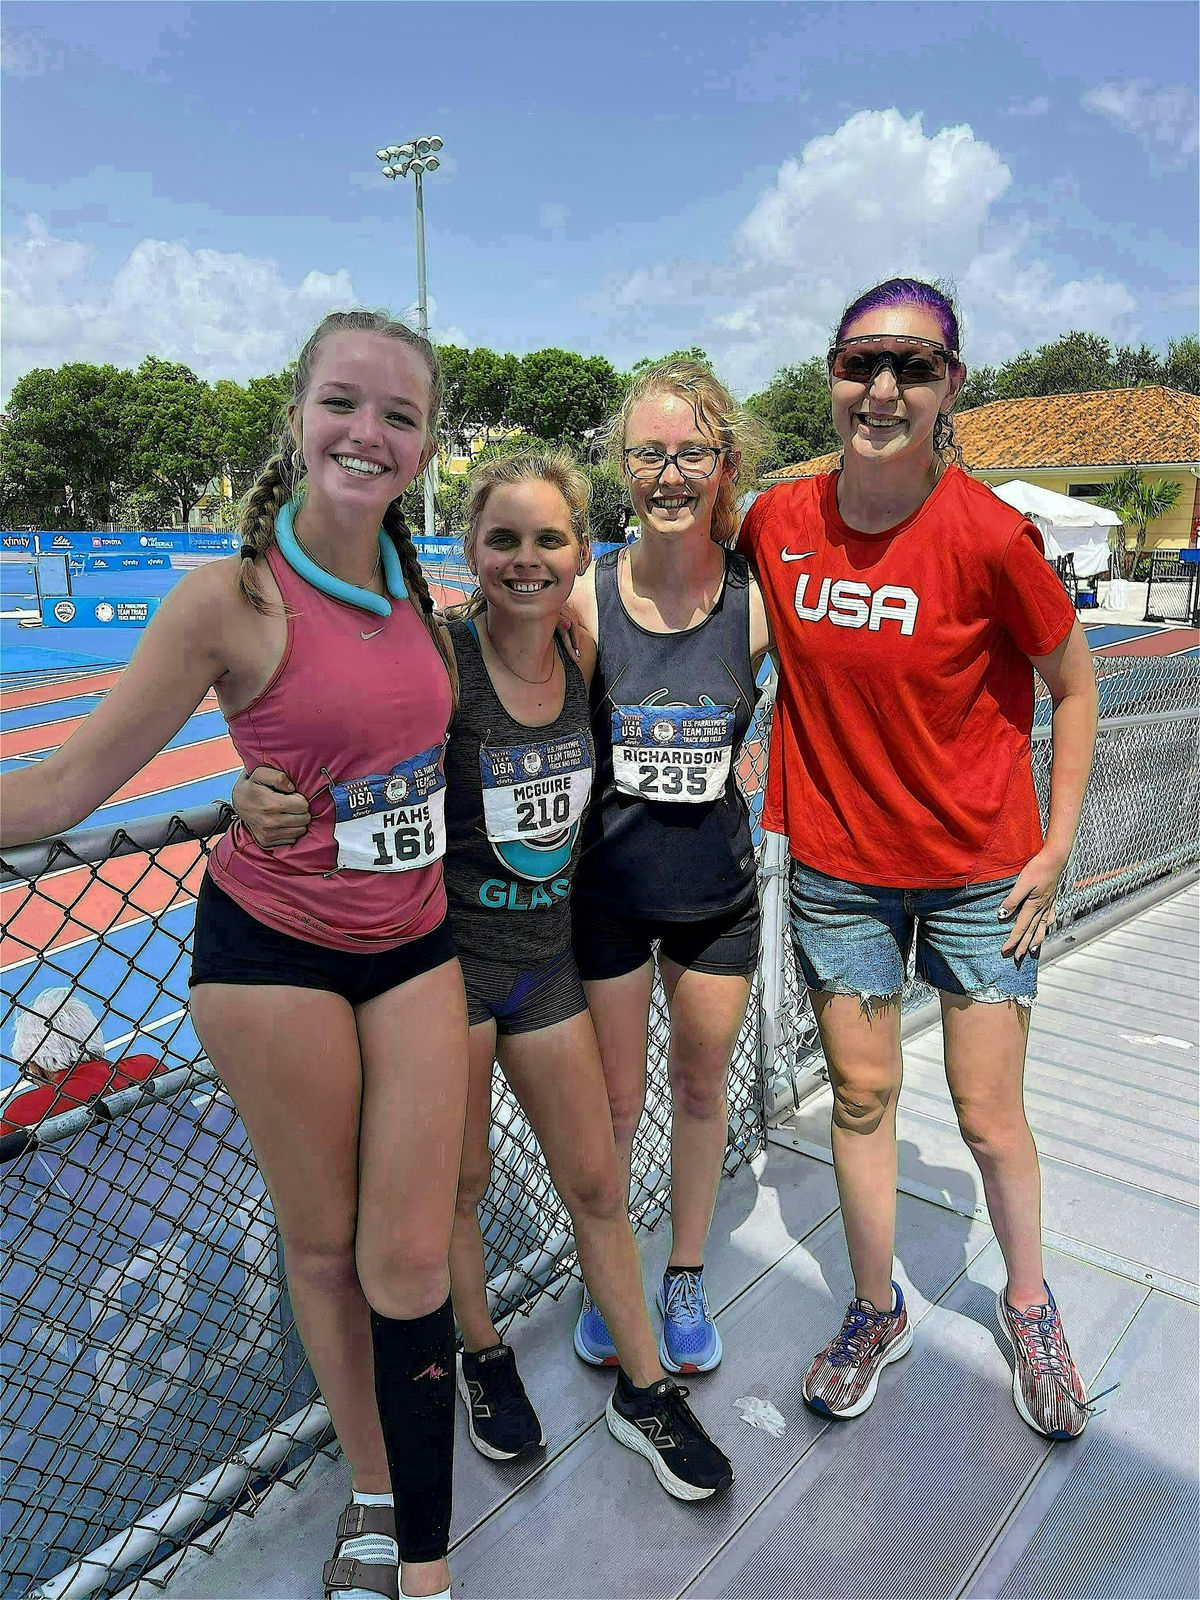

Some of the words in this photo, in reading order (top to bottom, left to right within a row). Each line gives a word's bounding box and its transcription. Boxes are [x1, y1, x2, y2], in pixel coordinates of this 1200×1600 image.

[3, 536, 30, 547] xfinity
[794, 573, 919, 636] USA
[694, 719, 727, 728] PARALYMPIC
[621, 725, 643, 738] USA
[682, 727, 701, 737] TEAM
[702, 726, 727, 736] TRIALS
[710, 735, 722, 743] FIELD
[547, 752, 563, 763] TEAM
[563, 748, 582, 760] TRIALS
[623, 749, 723, 765] RICHARDSON
[413, 769, 424, 779] U.S.
[491, 762, 515, 776] USA
[638, 765, 707, 796] 235
[513, 776, 571, 802] MCGUIRE
[348, 791, 375, 809] USA
[383, 805, 430, 828] HAHS
[516, 792, 570, 832] 210
[372, 819, 435, 866] 166
